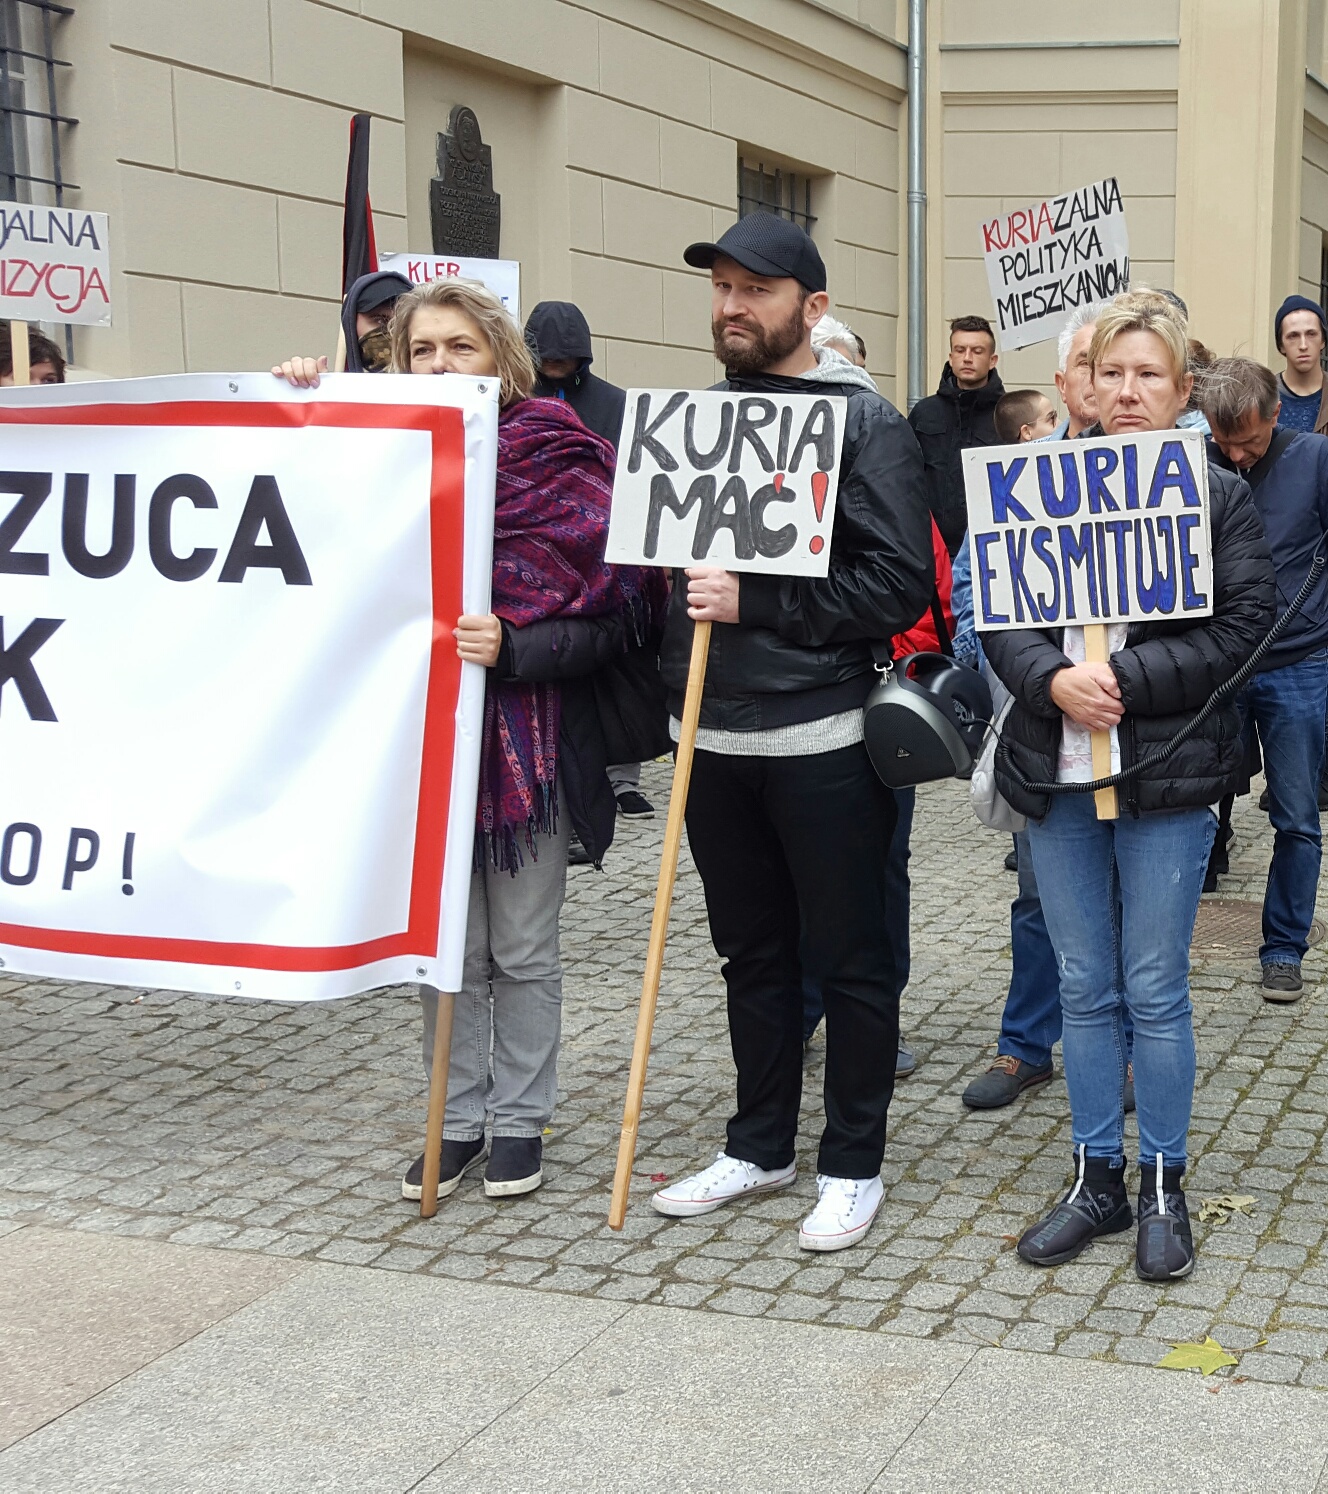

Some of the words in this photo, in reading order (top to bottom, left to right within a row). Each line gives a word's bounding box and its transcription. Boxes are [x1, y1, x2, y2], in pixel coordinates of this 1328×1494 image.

[999, 225, 1104, 286] POLITYKA
[627, 391, 836, 474] KURIA
[986, 440, 1202, 525] KURIA
[974, 513, 1208, 625] EKSMITUJE
